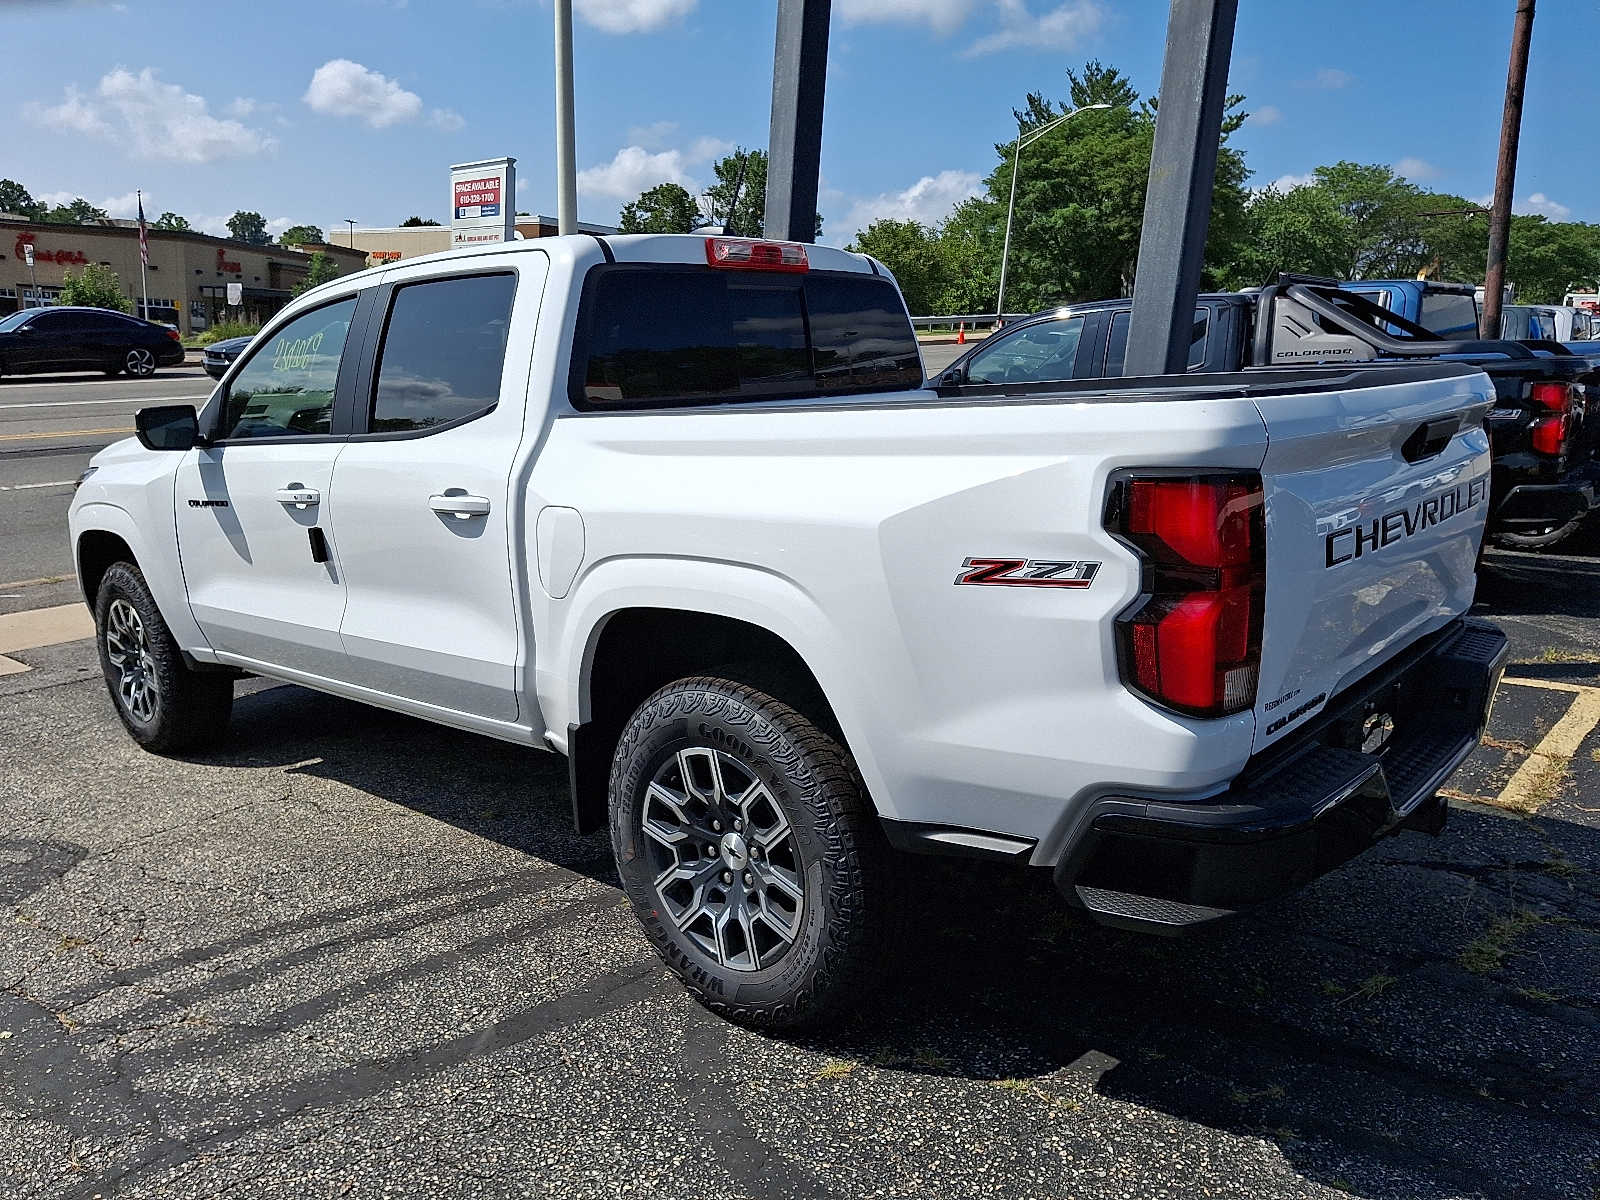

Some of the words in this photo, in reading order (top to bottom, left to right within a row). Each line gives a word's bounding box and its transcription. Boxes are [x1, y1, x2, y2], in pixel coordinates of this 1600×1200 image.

[456, 183, 471, 193] SPACE
[472, 180, 499, 191] AVAILABLE
[1276, 348, 1353, 358] COLORADO
[188, 499, 228, 507] COLORADO
[1325, 477, 1487, 569] CHEVROLET
[953, 556, 1102, 589] Z71
